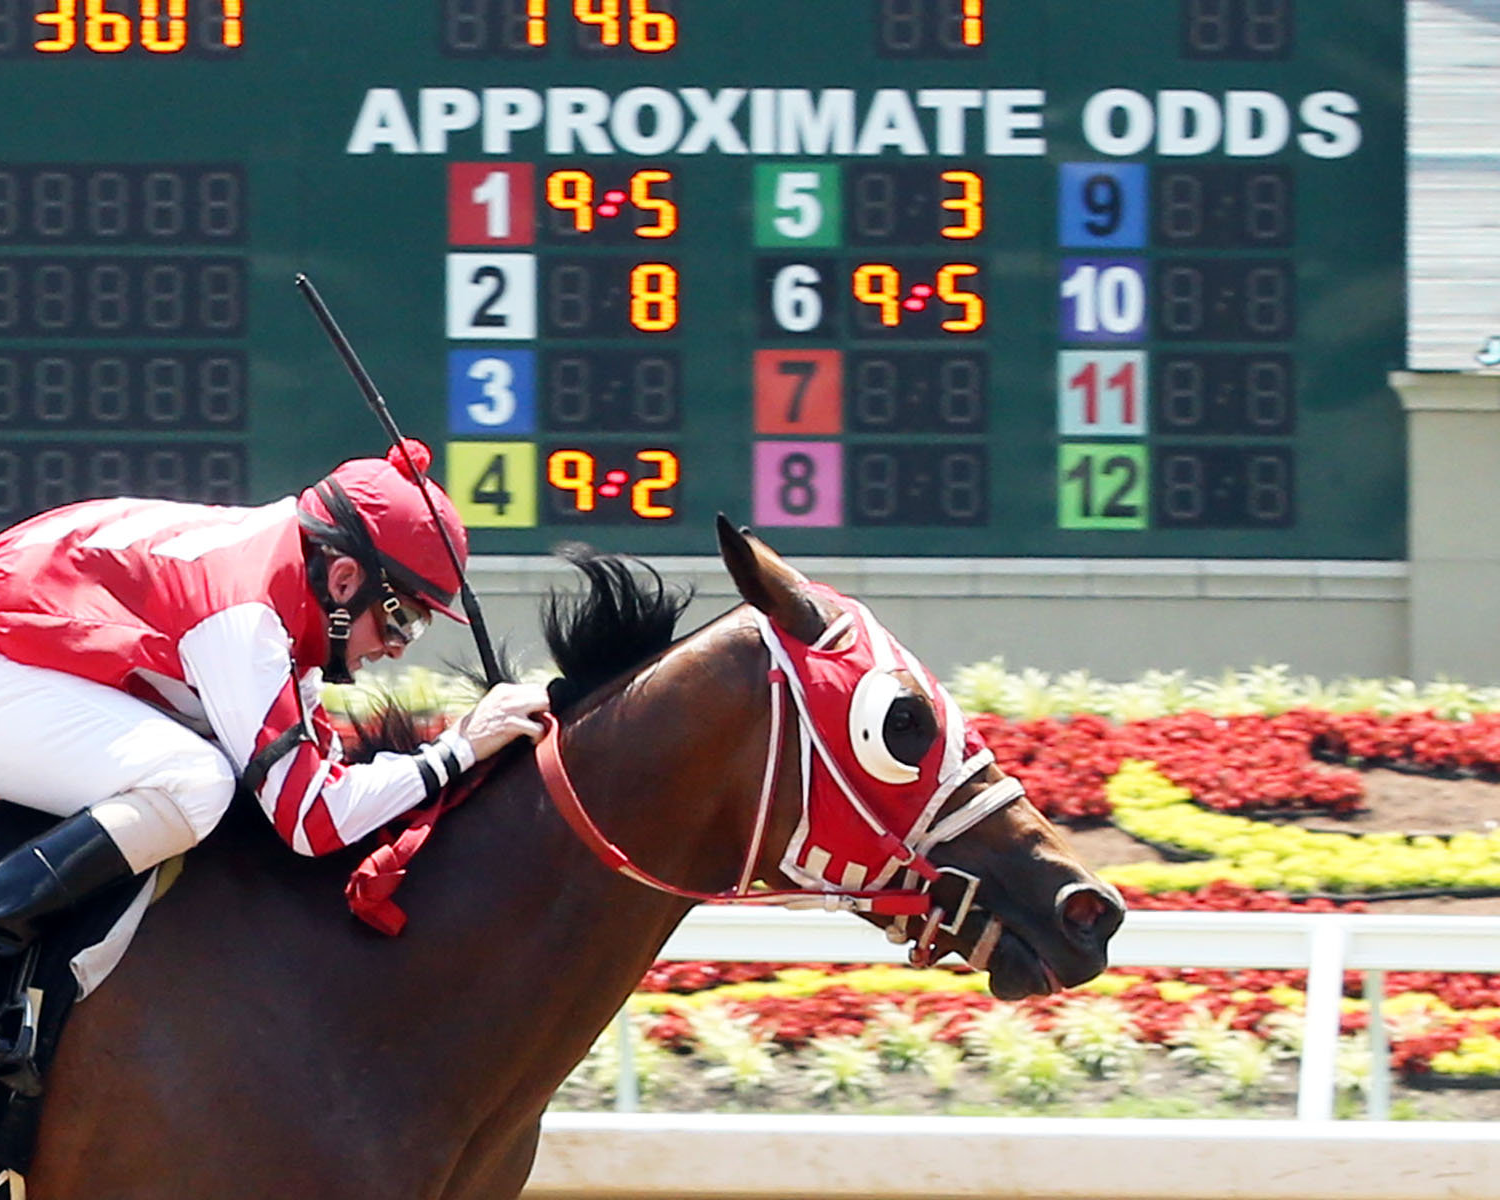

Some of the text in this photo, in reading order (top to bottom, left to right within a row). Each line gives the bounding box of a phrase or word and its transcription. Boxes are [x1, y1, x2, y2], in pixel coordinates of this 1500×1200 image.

[346, 87, 1361, 158] APPROXIMATE ODDS
[472, 171, 510, 238] 1
[773, 170, 983, 239] 5 3
[1081, 173, 1125, 238] 9
[471, 263, 679, 332] 2 8
[773, 264, 821, 331] 6
[1062, 265, 1146, 333] 10
[467, 358, 516, 425] 3
[776, 361, 818, 422] 7
[1069, 363, 1136, 425] 11
[471, 453, 517, 516] 4
[778, 452, 817, 516] 8
[1066, 453, 1143, 520] 12
